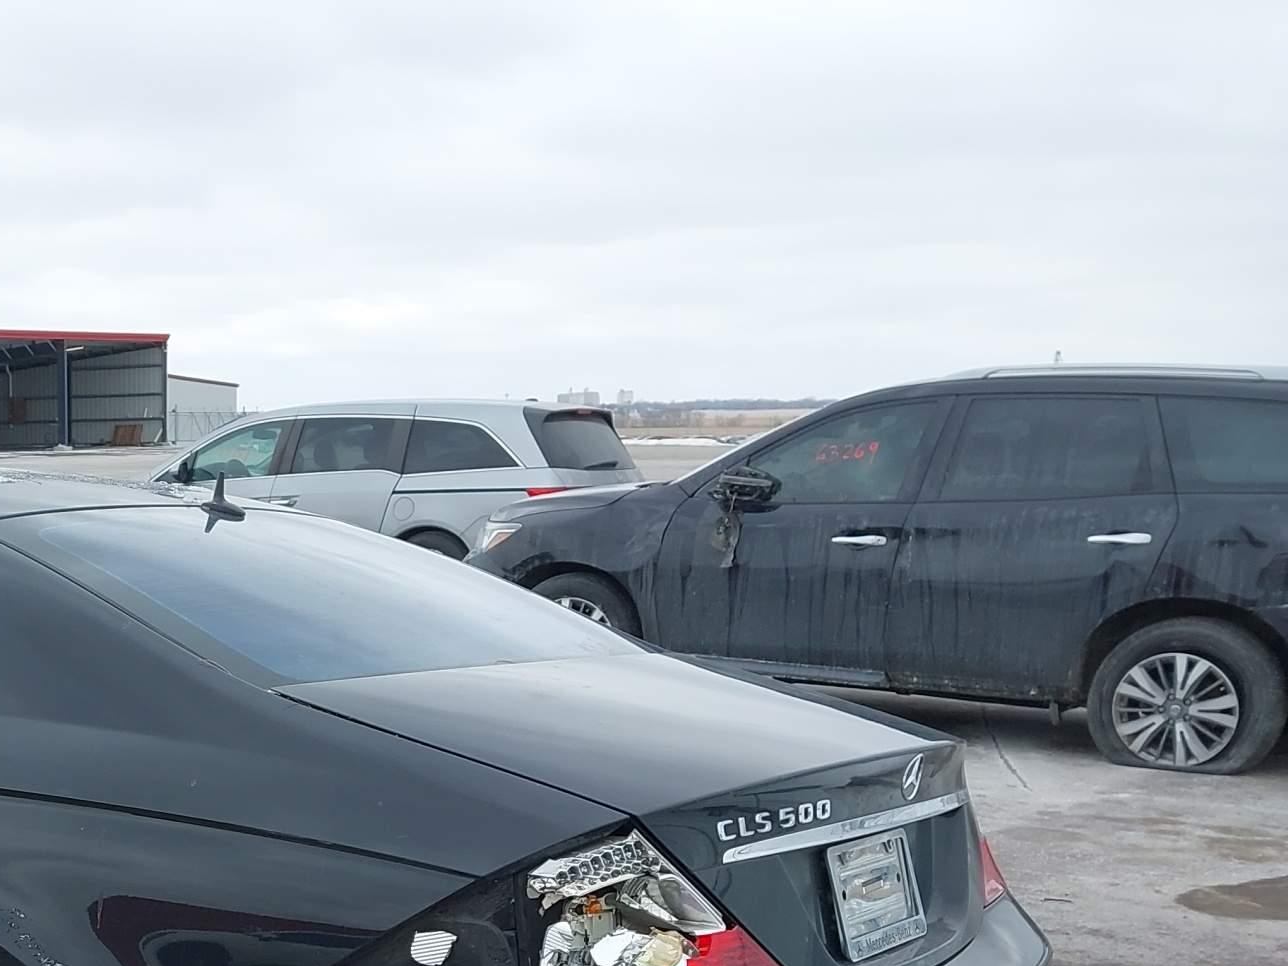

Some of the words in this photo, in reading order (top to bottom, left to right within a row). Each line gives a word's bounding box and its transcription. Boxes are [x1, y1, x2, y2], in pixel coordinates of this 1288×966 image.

[716, 811, 773, 842] CLS
[778, 799, 831, 829] 500
[865, 924, 912, 951] Mercedes-Benz
